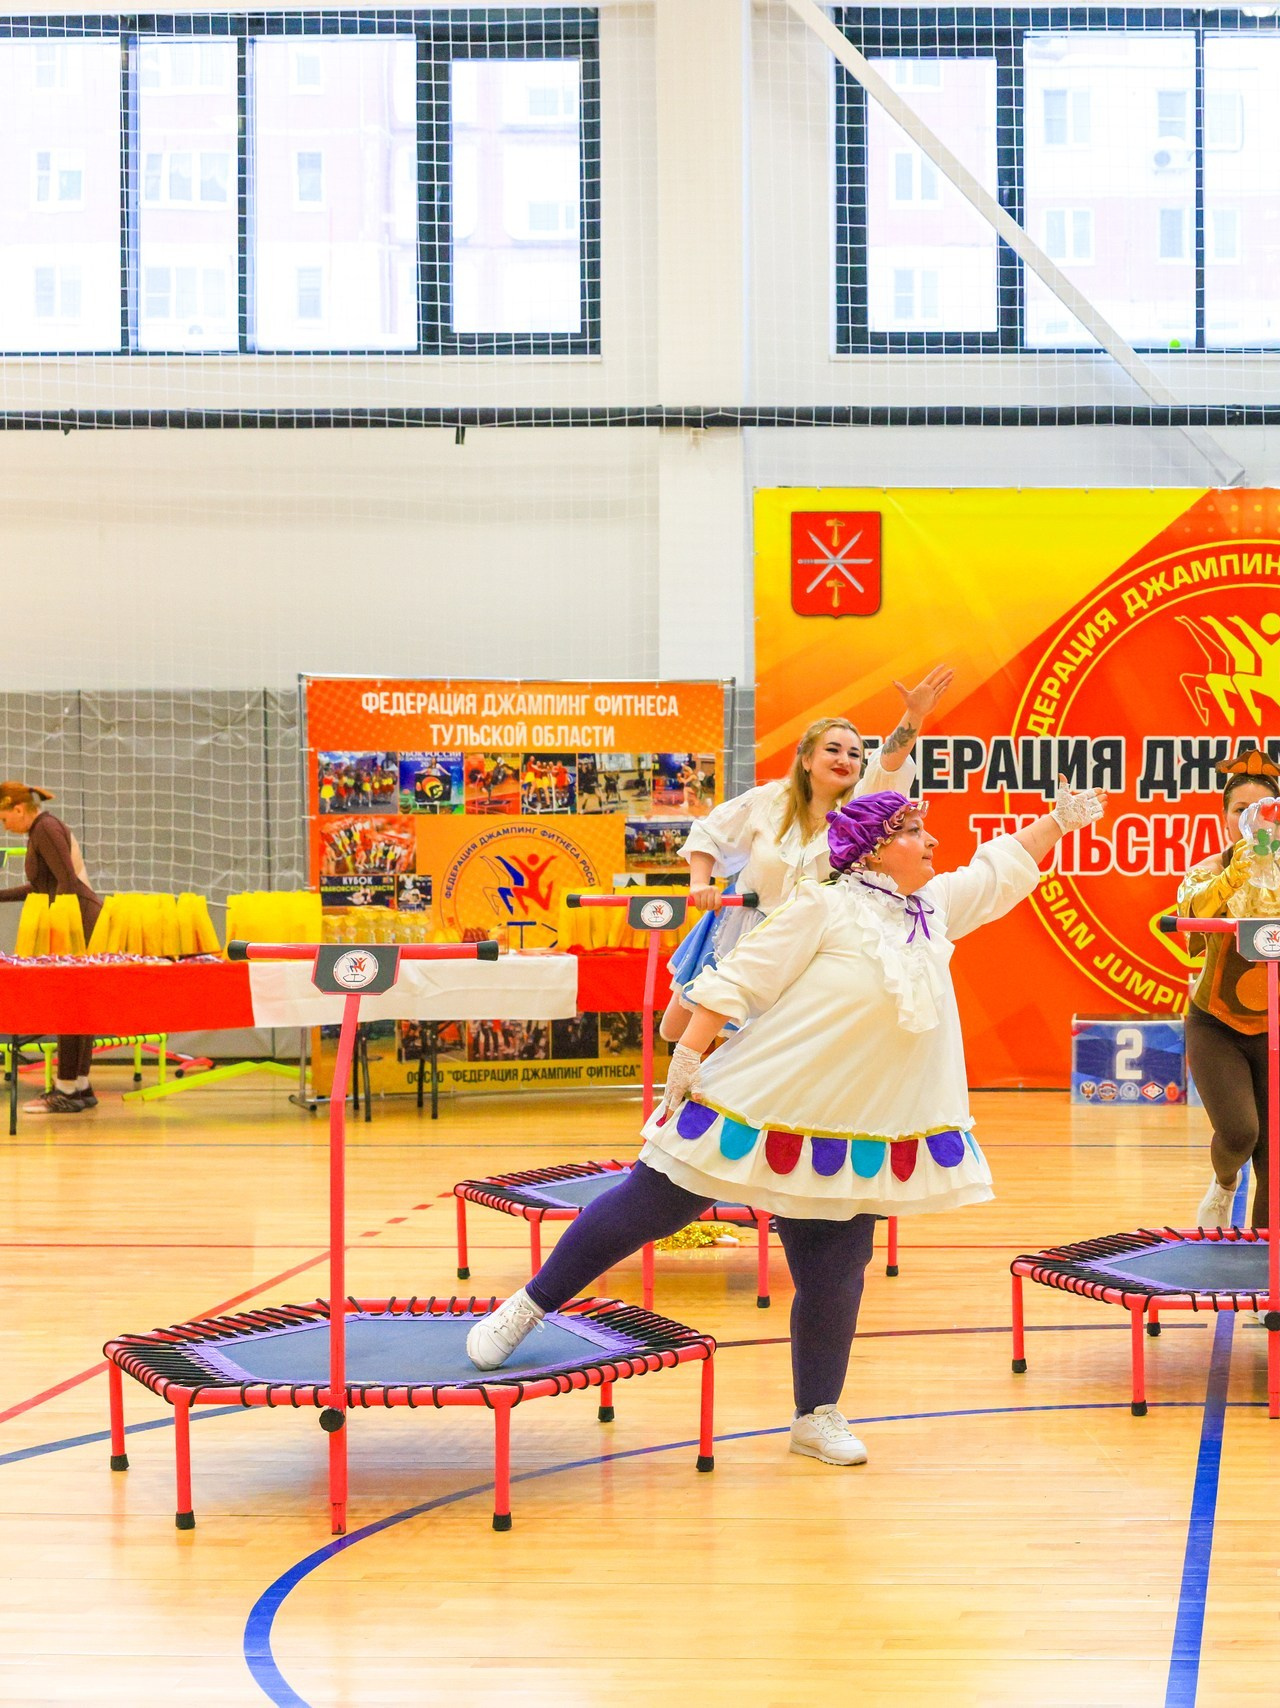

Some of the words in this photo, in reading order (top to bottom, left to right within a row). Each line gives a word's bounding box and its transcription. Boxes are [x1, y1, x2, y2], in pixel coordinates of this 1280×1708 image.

[1026, 607, 1119, 737] ДЕРАЦИЯ
[361, 691, 477, 717] ФЕДЕРАЦИЯ
[481, 693, 590, 718] ДЖАМПИНГ
[594, 694, 679, 717] ФИТНЕСА
[429, 721, 528, 747] ТУЛЬСКОЙ
[532, 725, 615, 747] ОБЛАСТИ
[444, 842, 478, 899] ФЕДЕРАЦИЯ
[479, 826, 538, 846] ДЖАМПИНГ
[540, 829, 582, 860] ФИТНЕСА
[579, 859, 596, 887] РОСС
[447, 1068, 519, 1083] "ФЕДЕРАЦИЯ
[521, 1066, 584, 1082] ДЖАМПИНГ
[587, 1064, 641, 1078] ФИТНЕСА"
[1115, 1028, 1143, 1080] 2
